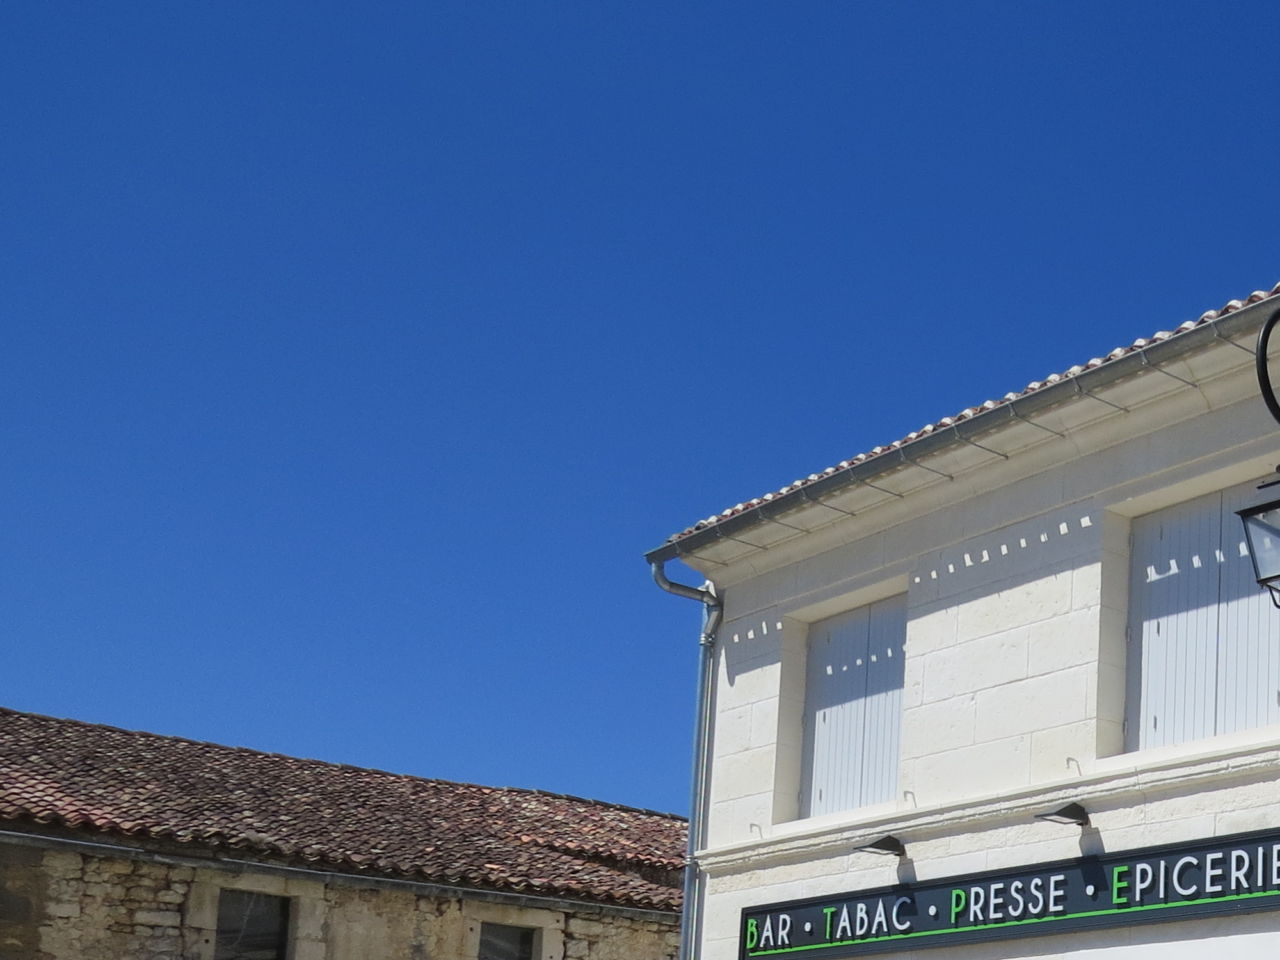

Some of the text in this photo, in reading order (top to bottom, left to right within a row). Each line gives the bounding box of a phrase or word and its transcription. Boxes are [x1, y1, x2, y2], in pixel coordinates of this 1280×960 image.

[746, 914, 792, 949] BAR
[823, 896, 912, 939] TABAC
[951, 874, 1065, 924] PRESSE
